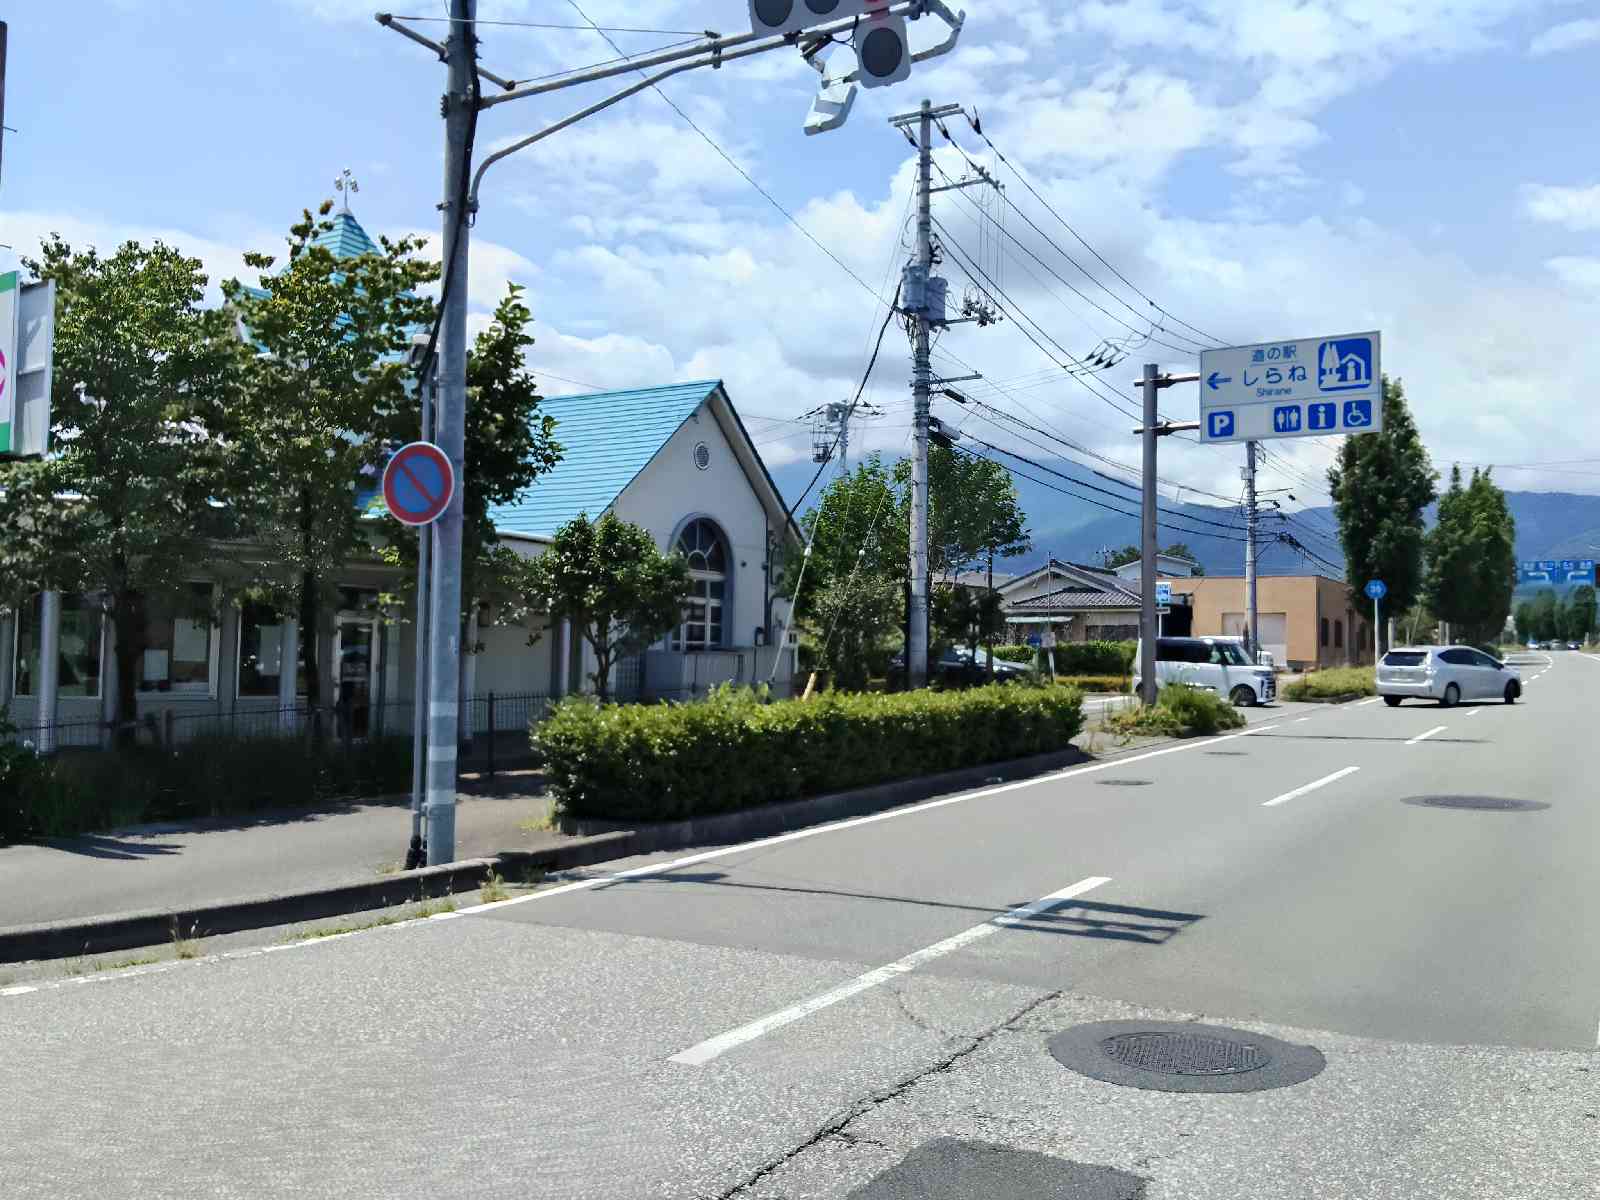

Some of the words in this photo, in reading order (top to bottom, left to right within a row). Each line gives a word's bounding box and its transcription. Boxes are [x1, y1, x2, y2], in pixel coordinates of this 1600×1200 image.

[1243, 366, 1307, 387] しらね
[1256, 387, 1292, 397] Shirane
